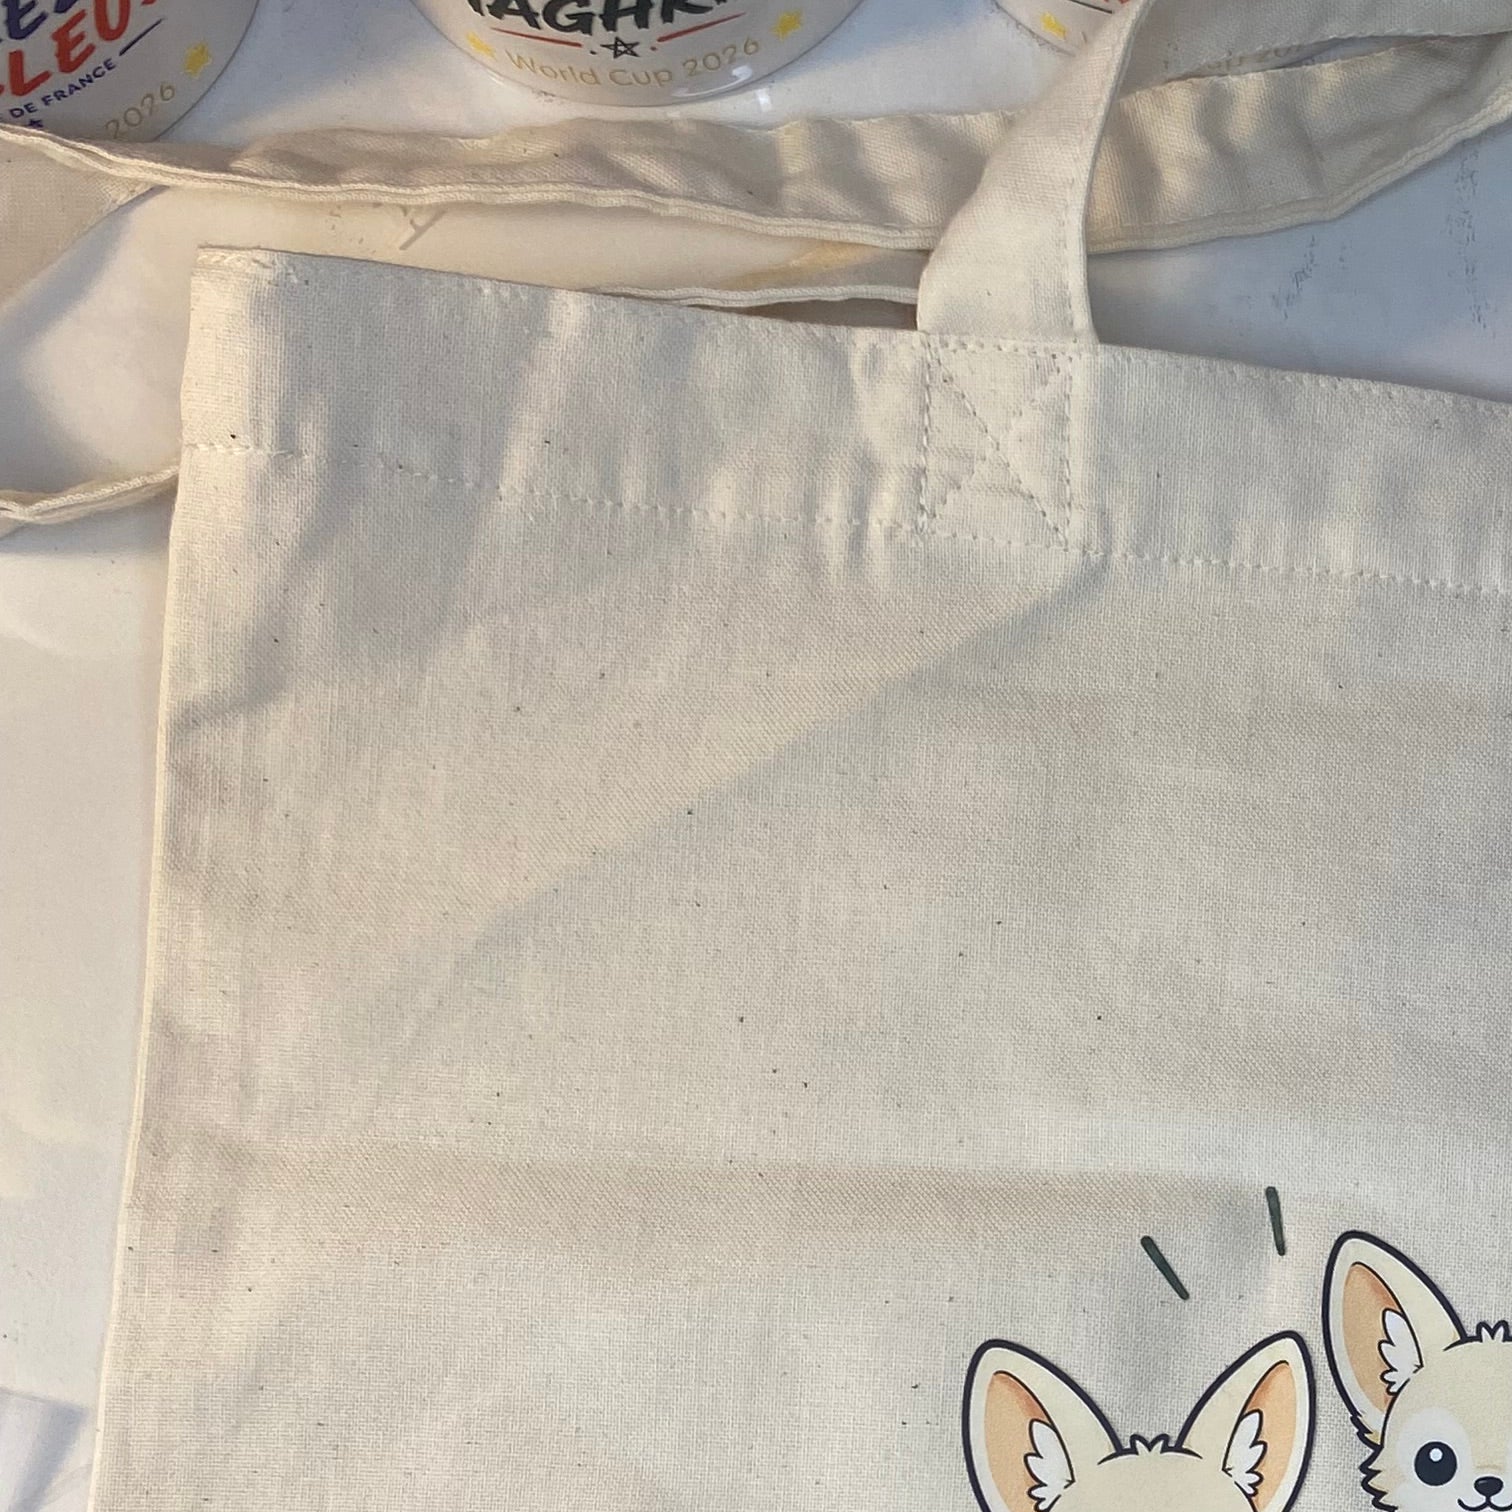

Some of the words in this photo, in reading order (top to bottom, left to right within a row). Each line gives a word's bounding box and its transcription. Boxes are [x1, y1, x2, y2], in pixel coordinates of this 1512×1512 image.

[0, 0, 156, 97] LEU
[504, 49, 598, 85] World
[609, 68, 673, 87] Cup
[682, 37, 760, 77] 2026
[9, 102, 38, 118] DE
[41, 58, 117, 106] FRANCE
[105, 83, 175, 138] 2026
